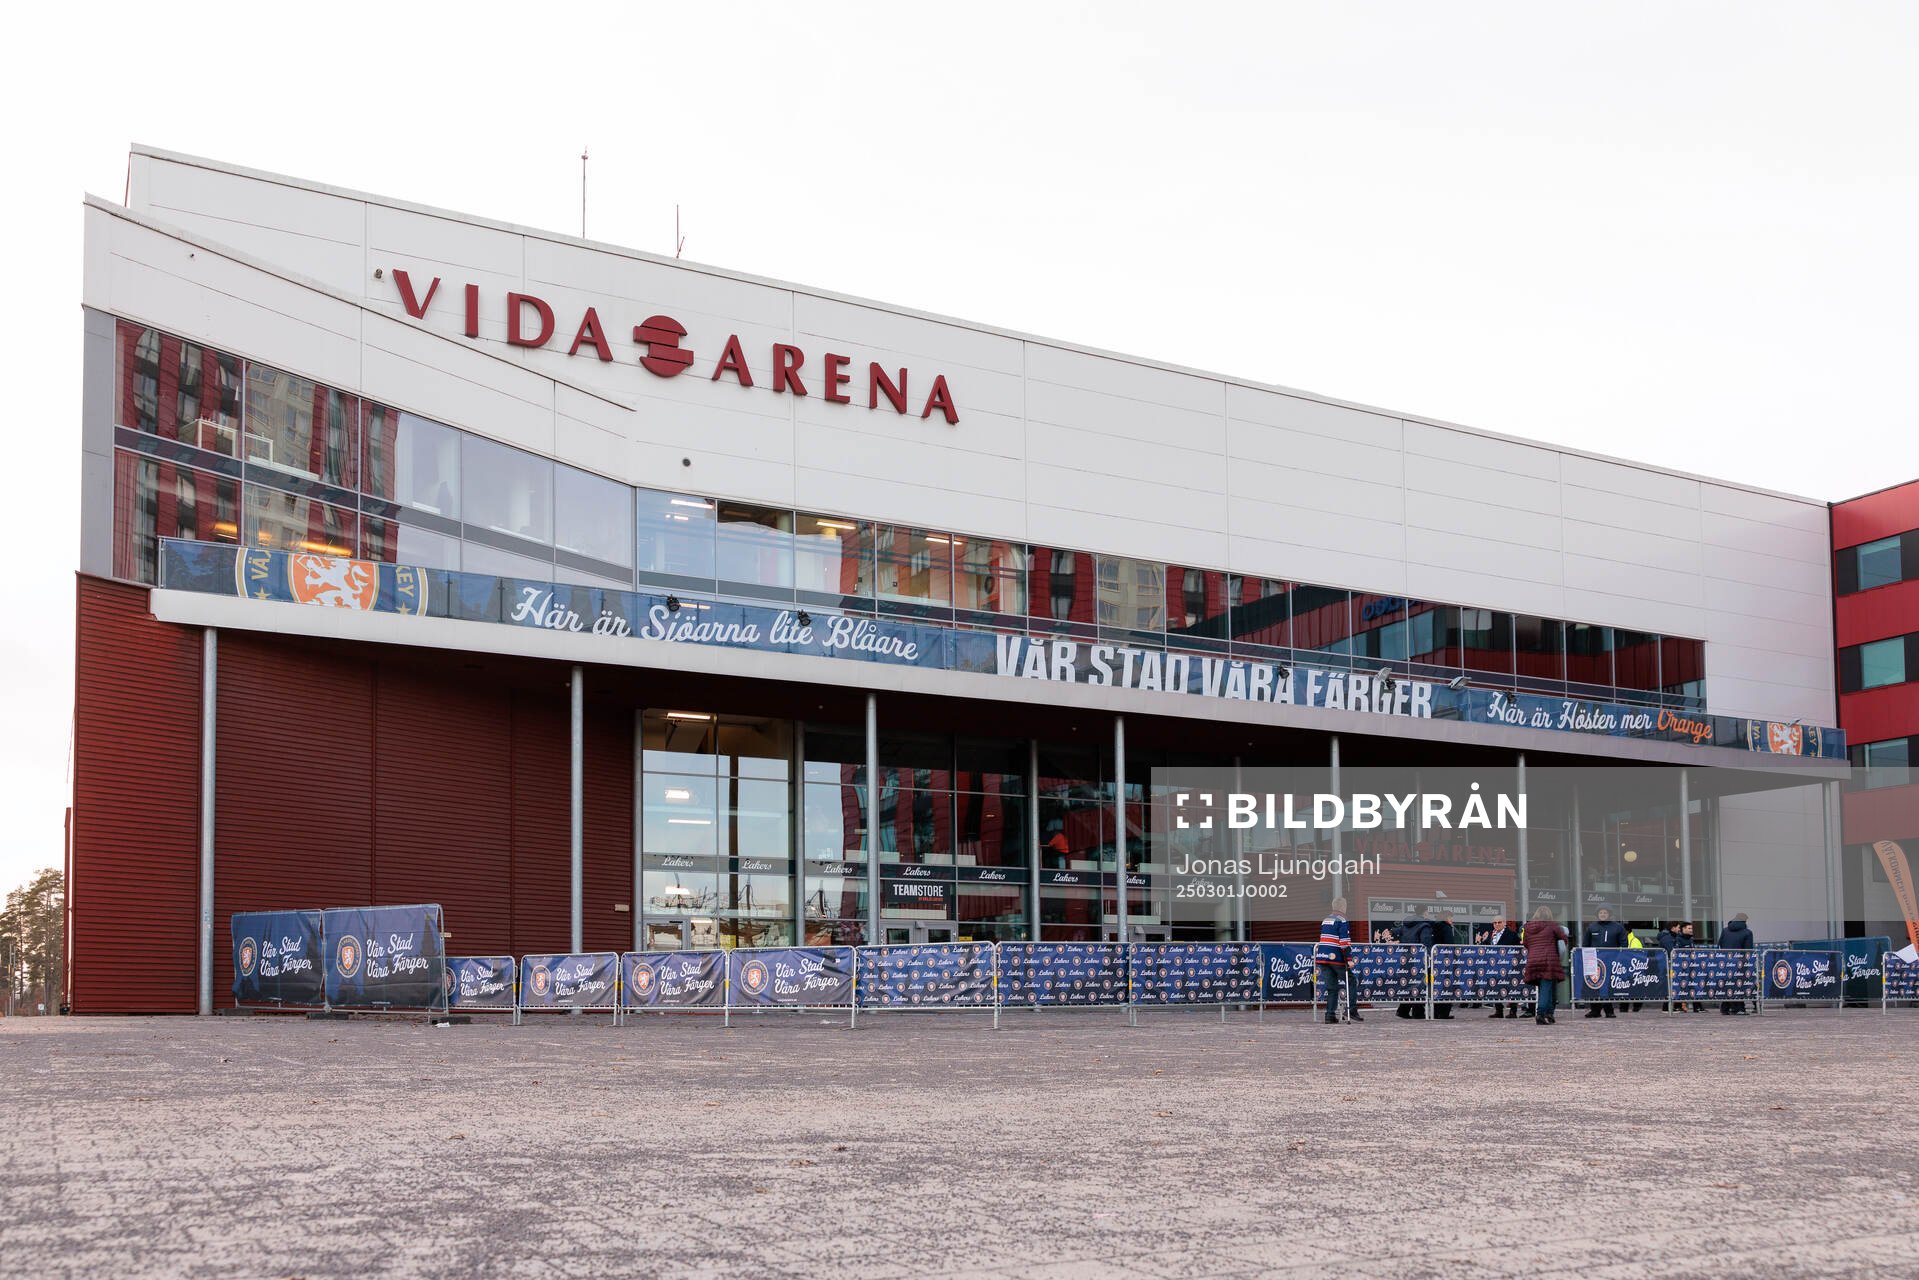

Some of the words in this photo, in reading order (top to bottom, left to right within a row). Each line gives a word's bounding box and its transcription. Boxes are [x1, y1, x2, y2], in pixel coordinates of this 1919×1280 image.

[391, 268, 613, 362] VIDA
[711, 334, 960, 425] ARENA
[510, 586, 584, 631] Här
[593, 610, 631, 638] är
[640, 604, 761, 643] Sjöarna
[769, 610, 814, 645] lite
[822, 615, 920, 660] Blåare
[997, 634, 1078, 683] VÅR
[1088, 644, 1190, 695] STAD
[1202, 659, 1297, 705] VÅRA
[1306, 669, 1432, 719] FÄRGER
[1486, 691, 1527, 726] Här
[1531, 707, 1553, 730] är
[1556, 702, 1617, 730] Hösten
[1620, 712, 1652, 730] mer
[1656, 709, 1714, 743] Orange
[661, 856, 694, 868] Lakers
[742, 859, 772, 871] Lakers
[824, 863, 853, 874] Lakers
[903, 866, 931, 877] Lakers
[979, 870, 1006, 881] Lakers
[1053, 873, 1079, 883] Lakers
[893, 884, 944, 897] TEAMSTORE
[262, 940, 277, 958] Vår
[279, 936, 302, 954] Stad
[367, 939, 384, 957] Vår
[388, 933, 413, 954] Stad
[260, 959, 279, 976] Våra
[281, 953, 312, 974] Färger
[367, 959, 389, 978] Våra
[392, 952, 429, 974] Färger
[776, 963, 795, 977] Vår
[799, 958, 825, 974] Stad
[1271, 957, 1290, 972] Vår
[1611, 961, 1626, 974] Vår
[1629, 958, 1648, 972] Stad
[1796, 963, 1810, 975] Vår
[1812, 960, 1829, 973] Stad
[1847, 954, 1867, 968] Stad
[461, 970, 474, 982] Vår
[477, 965, 494, 980] Stad
[556, 968, 571, 981] Vår
[574, 963, 595, 978] Stad
[661, 966, 677, 979] Vår
[680, 961, 702, 977] Stad
[1851, 966, 1880, 979] Färger
[461, 983, 478, 996] Våra
[480, 979, 504, 994] Färger
[555, 982, 575, 995] Våra
[578, 977, 606, 993] Färger
[661, 981, 682, 995] Våra
[684, 976, 714, 992] Färger
[775, 979, 800, 994] Våra
[803, 973, 840, 990] Färger
[1270, 973, 1294, 988] Våra
[1611, 975, 1630, 989] Våra
[1632, 971, 1659, 987] Färger
[1796, 976, 1812, 988] Våra
[1813, 973, 1835, 986] Färger
